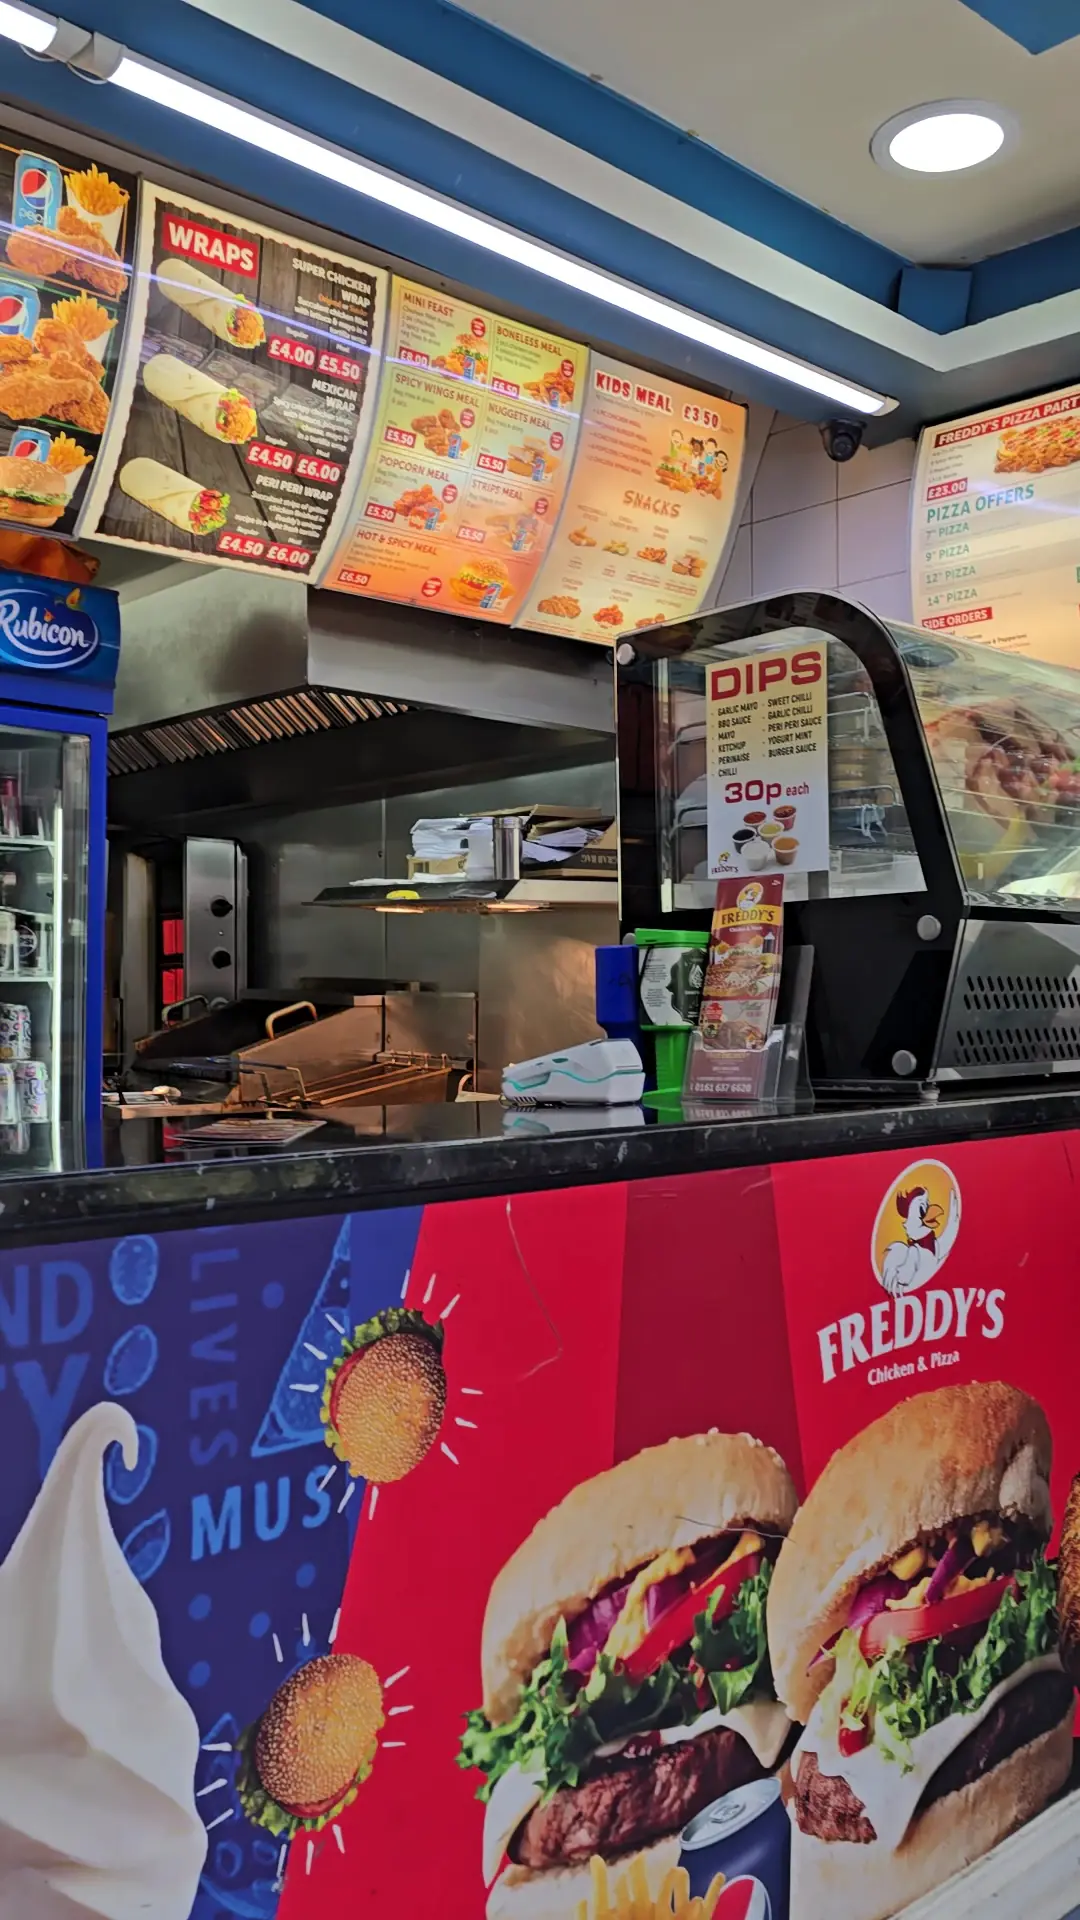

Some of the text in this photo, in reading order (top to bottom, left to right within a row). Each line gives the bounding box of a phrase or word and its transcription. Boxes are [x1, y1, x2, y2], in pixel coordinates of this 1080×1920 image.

[168, 222, 255, 272] WRAPS
[292, 257, 371, 295] SUPER CHICKEN
[341, 289, 371, 308] WRAP
[403, 292, 454, 319] MINI FEAST
[496, 326, 539, 349] BONELESS
[540, 341, 563, 357] MEAL
[269, 339, 361, 380] £4.00 £5.50
[400, 349, 428, 366] £8.00
[312, 378, 358, 402] MEXICAN
[395, 373, 422, 389] SPICY
[424, 380, 454, 400] WINGS
[455, 391, 480, 408] MEAL
[595, 372, 631, 398] KIDS
[635, 386, 673, 413] MEAL
[325, 395, 356, 413] WRAP
[488, 401, 528, 423] NUGGETS
[529, 415, 552, 431] MEAL
[938, 418, 1000, 446] FREDDY'S
[1001, 407, 1040, 428] PIZZA
[386, 429, 413, 446] £5.50
[248, 446, 340, 482] £4.50 £6.00
[378, 455, 424, 477] POPCORN
[425, 468, 450, 483] MEAL
[478, 455, 504, 471] £5.50
[256, 474, 333, 502] PERI PERI WRAP
[471, 479, 501, 495] STRIPS
[502, 486, 525, 501] MEAL
[927, 480, 967, 500] £23.00
[366, 505, 394, 521] £5.50
[622, 490, 682, 518] SNACKS
[926, 484, 1034, 523] PIZZA OFFERS
[458, 527, 483, 542] £5.50
[938, 522, 969, 537] PIZZA
[219, 536, 310, 565] £4.50 £6.00
[356, 529, 378, 542] HOT
[378, 535, 386, 544] &
[386, 536, 415, 551] SPICY
[416, 542, 438, 556] MEAL
[939, 544, 969, 558] PIZZA
[339, 570, 368, 585] £6.50
[946, 565, 976, 580] PIZZA
[946, 588, 977, 602] PIZZA
[0, 599, 90, 648] Rubicon
[923, 609, 988, 630] SIDE ORDERS
[711, 650, 822, 702] DIPS
[718, 701, 758, 716] GARLIC MAYO
[767, 691, 812, 707] SWEET CHILLI
[718, 715, 752, 728] BBQ SAUCE
[768, 704, 813, 720] GARLIC CHILLI
[768, 716, 822, 732] PERI PERI SAUCE
[718, 730, 735, 740] MAYO
[768, 730, 812, 745] YOGURT MINT
[718, 741, 746, 753] KETCHUP
[768, 742, 817, 758] BURGER SAUCE
[718, 753, 750, 765] PERINAISE
[718, 767, 738, 777] CHILLI
[725, 780, 810, 805] 30p each
[721, 909, 775, 925] FREDDY'S
[816, 1287, 1006, 1384] FREDDY'S
[189, 1226, 240, 1467] LIVES
[867, 1350, 960, 1386] Chicken & Pizza
[0, 1353, 90, 1481] Y
[190, 1464, 331, 1561] MUS
